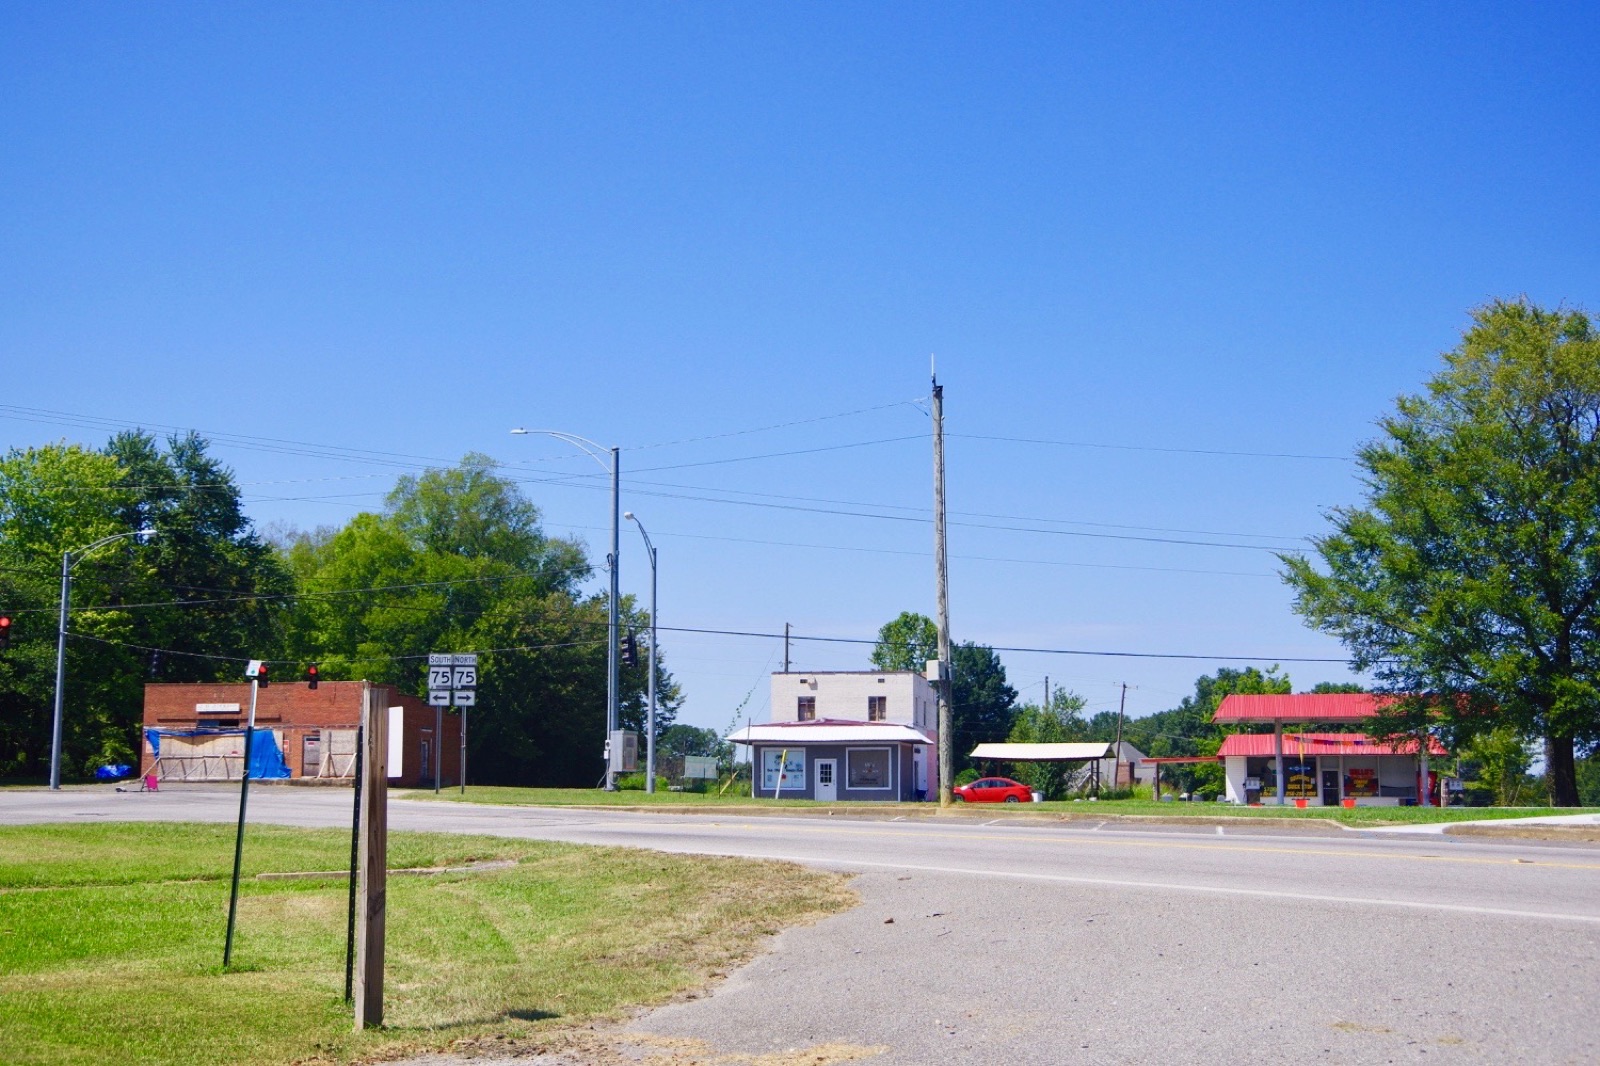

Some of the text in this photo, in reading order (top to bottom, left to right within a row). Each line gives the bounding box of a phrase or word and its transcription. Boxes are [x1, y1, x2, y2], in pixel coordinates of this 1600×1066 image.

[430, 655, 451, 664] SOUTH
[454, 655, 477, 664] NORTH
[431, 671, 450, 684] 75
[456, 671, 475, 684] 75
